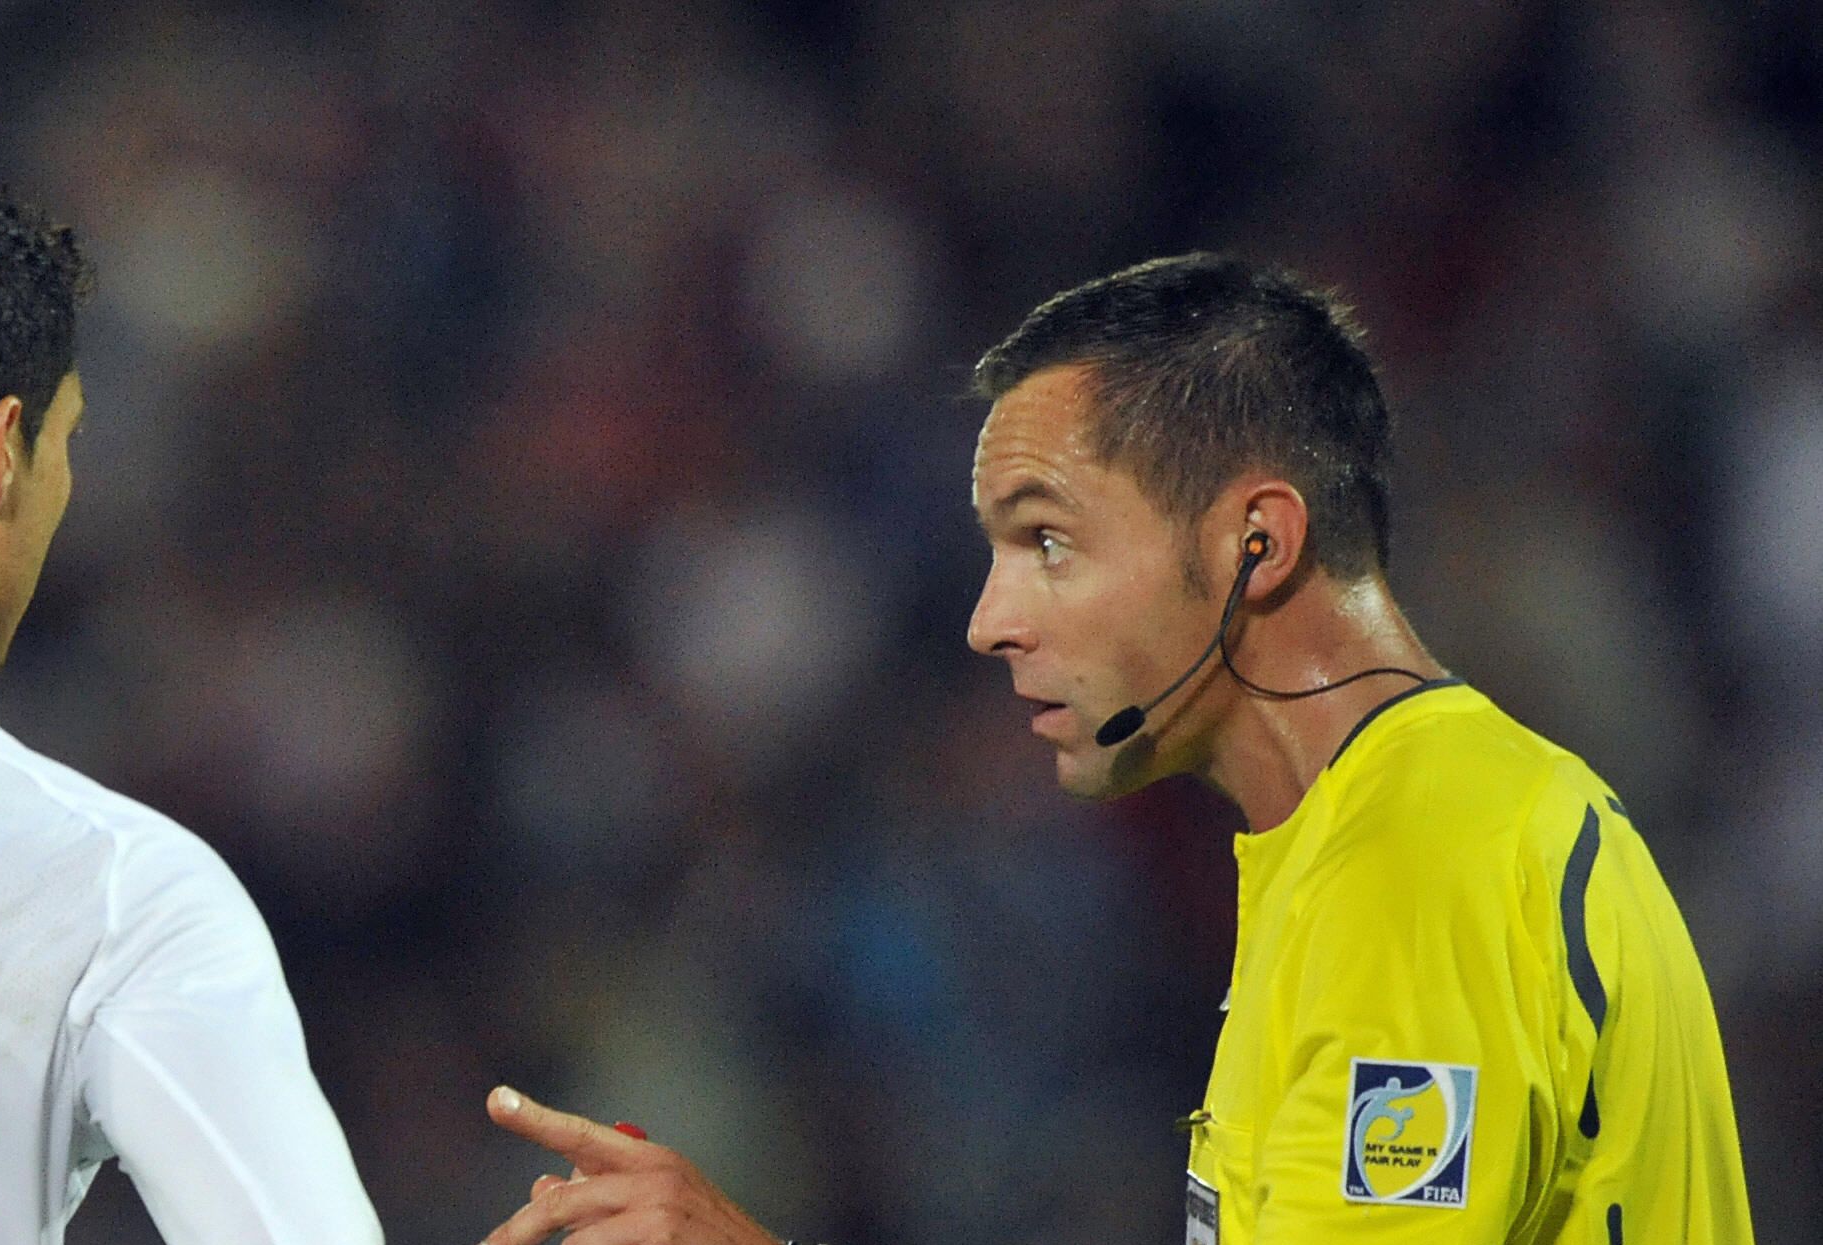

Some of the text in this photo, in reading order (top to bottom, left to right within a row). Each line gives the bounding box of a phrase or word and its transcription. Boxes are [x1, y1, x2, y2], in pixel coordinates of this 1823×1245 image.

[1365, 1143, 1384, 1153] MY
[1388, 1145, 1423, 1155] GAME
[1364, 1155, 1421, 1168] FAIR PLAY
[1423, 1186, 1461, 1203] FIFA
